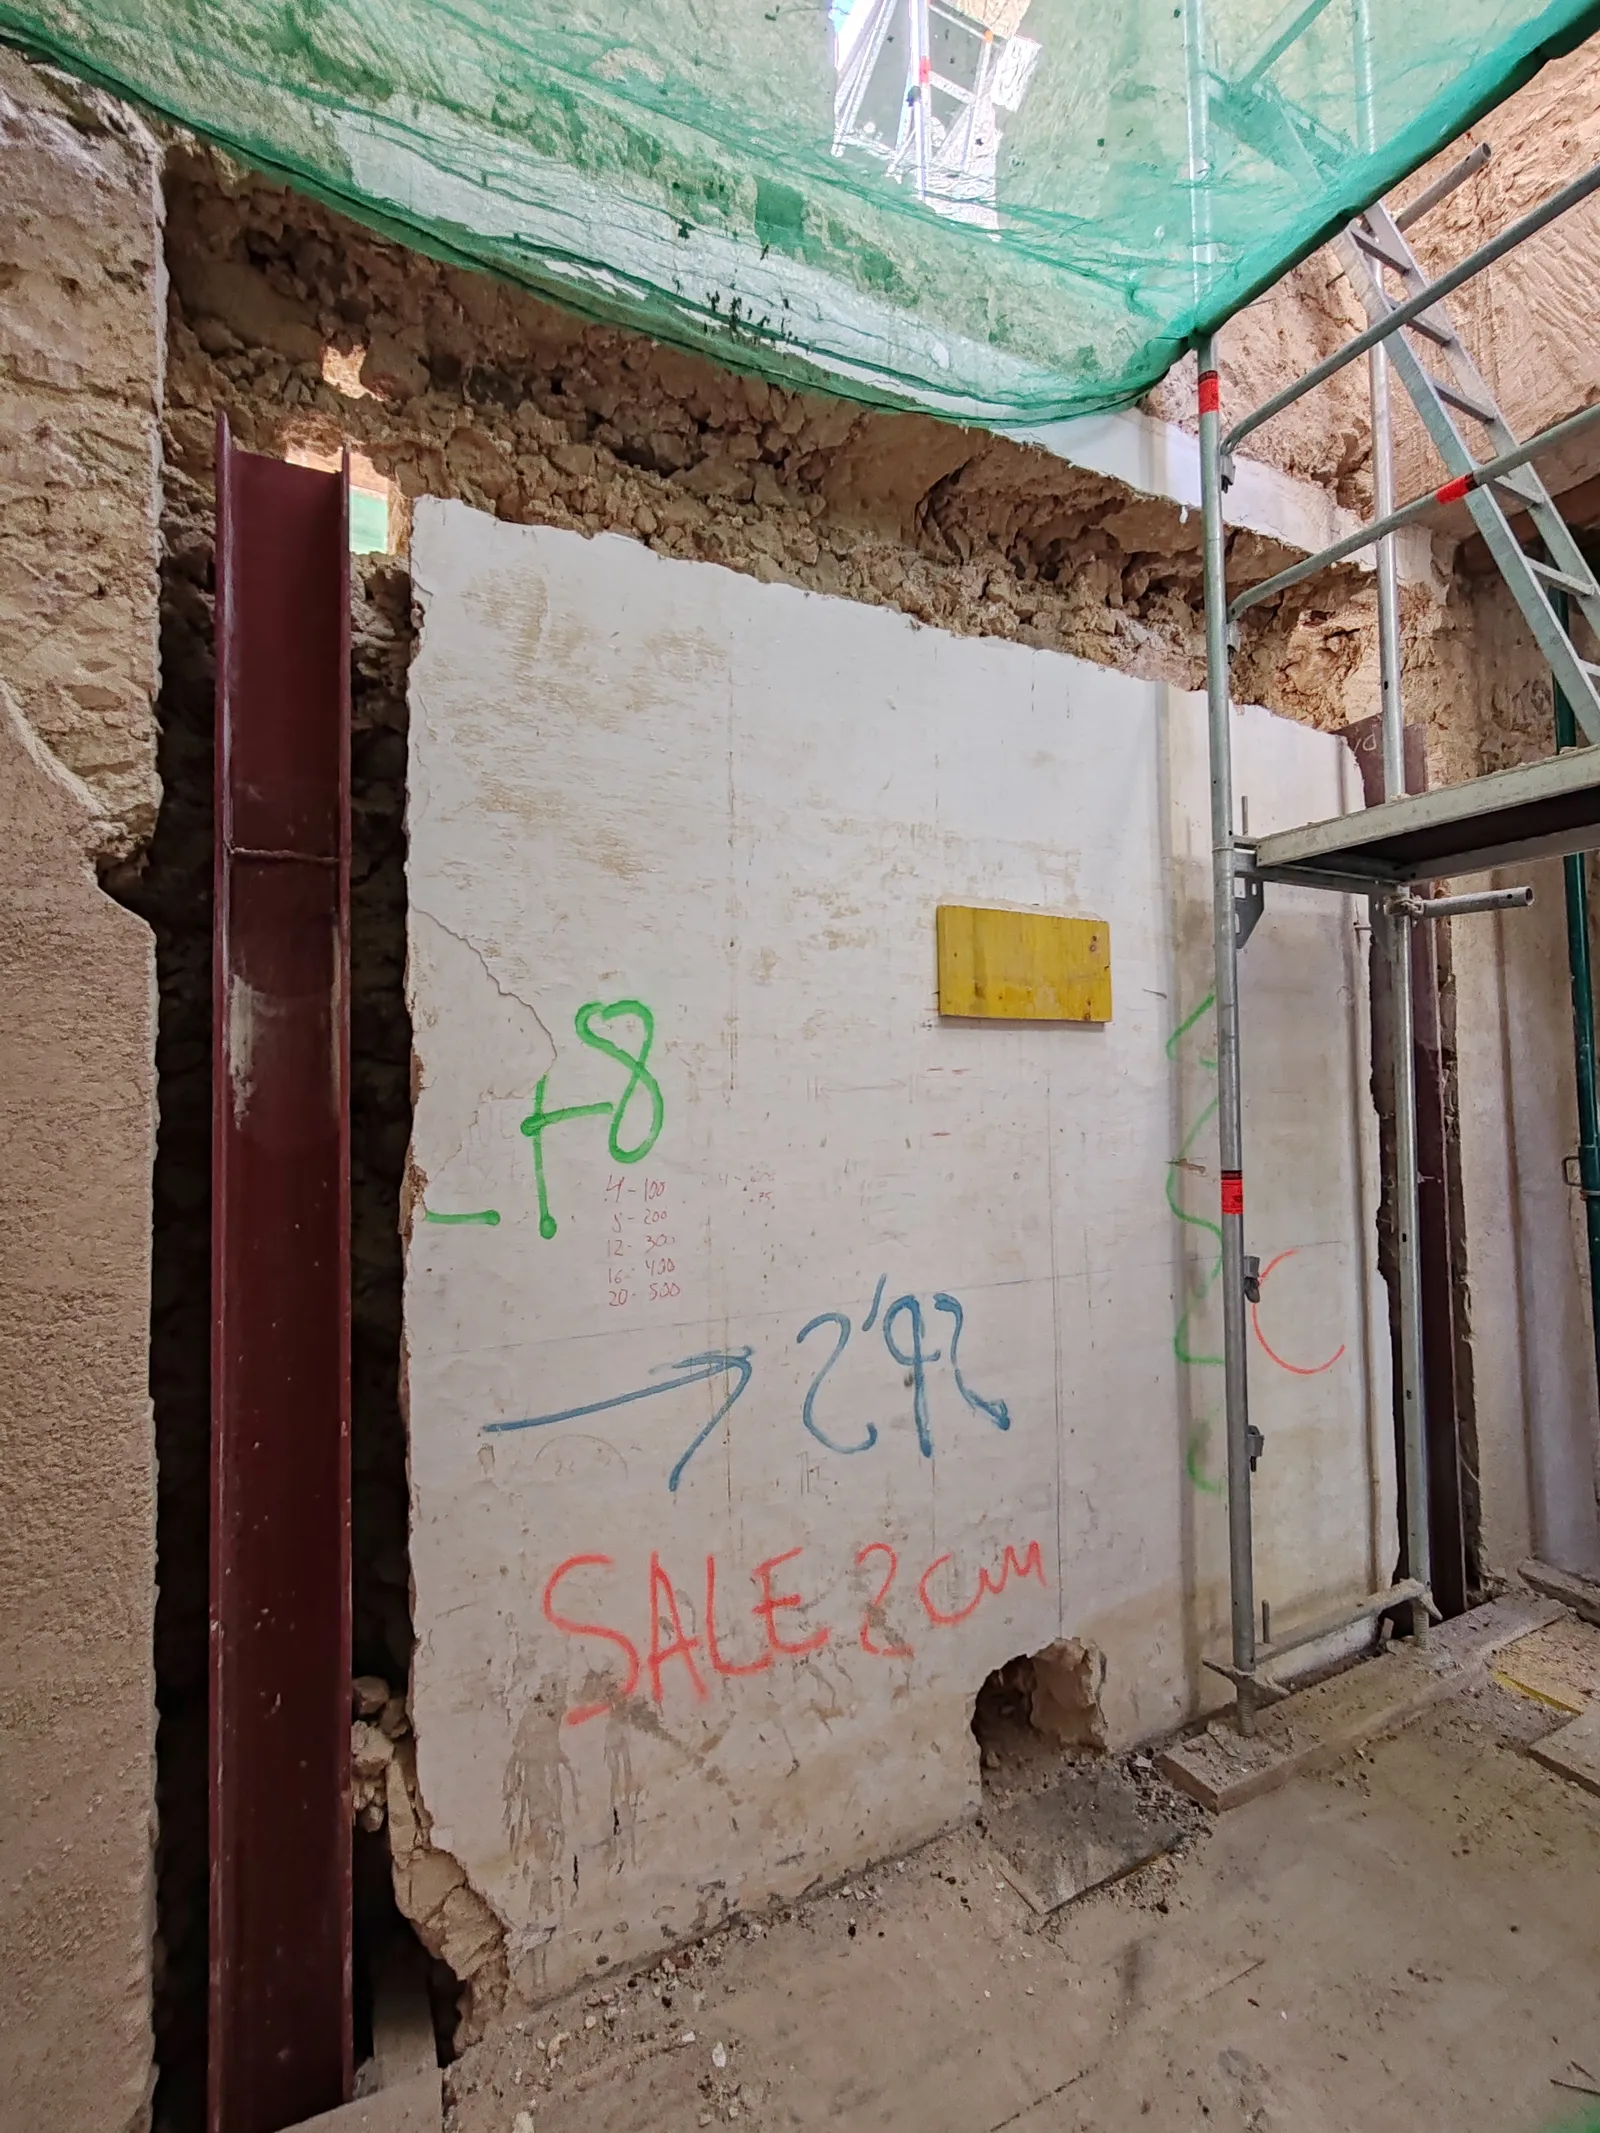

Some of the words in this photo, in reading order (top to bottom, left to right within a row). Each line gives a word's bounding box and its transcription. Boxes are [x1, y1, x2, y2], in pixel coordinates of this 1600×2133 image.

[605, 1174, 625, 1203] 4
[643, 1177, 667, 1203] 100
[643, 1206, 668, 1226] 200
[607, 1239, 624, 1258] 12
[644, 1233, 677, 1255] 300
[608, 1267, 623, 1285] 16
[644, 1258, 677, 1277] 400
[608, 1288, 629, 1307] 20
[648, 1282, 682, 1302] 500
[543, 1547, 831, 1727] SALE
